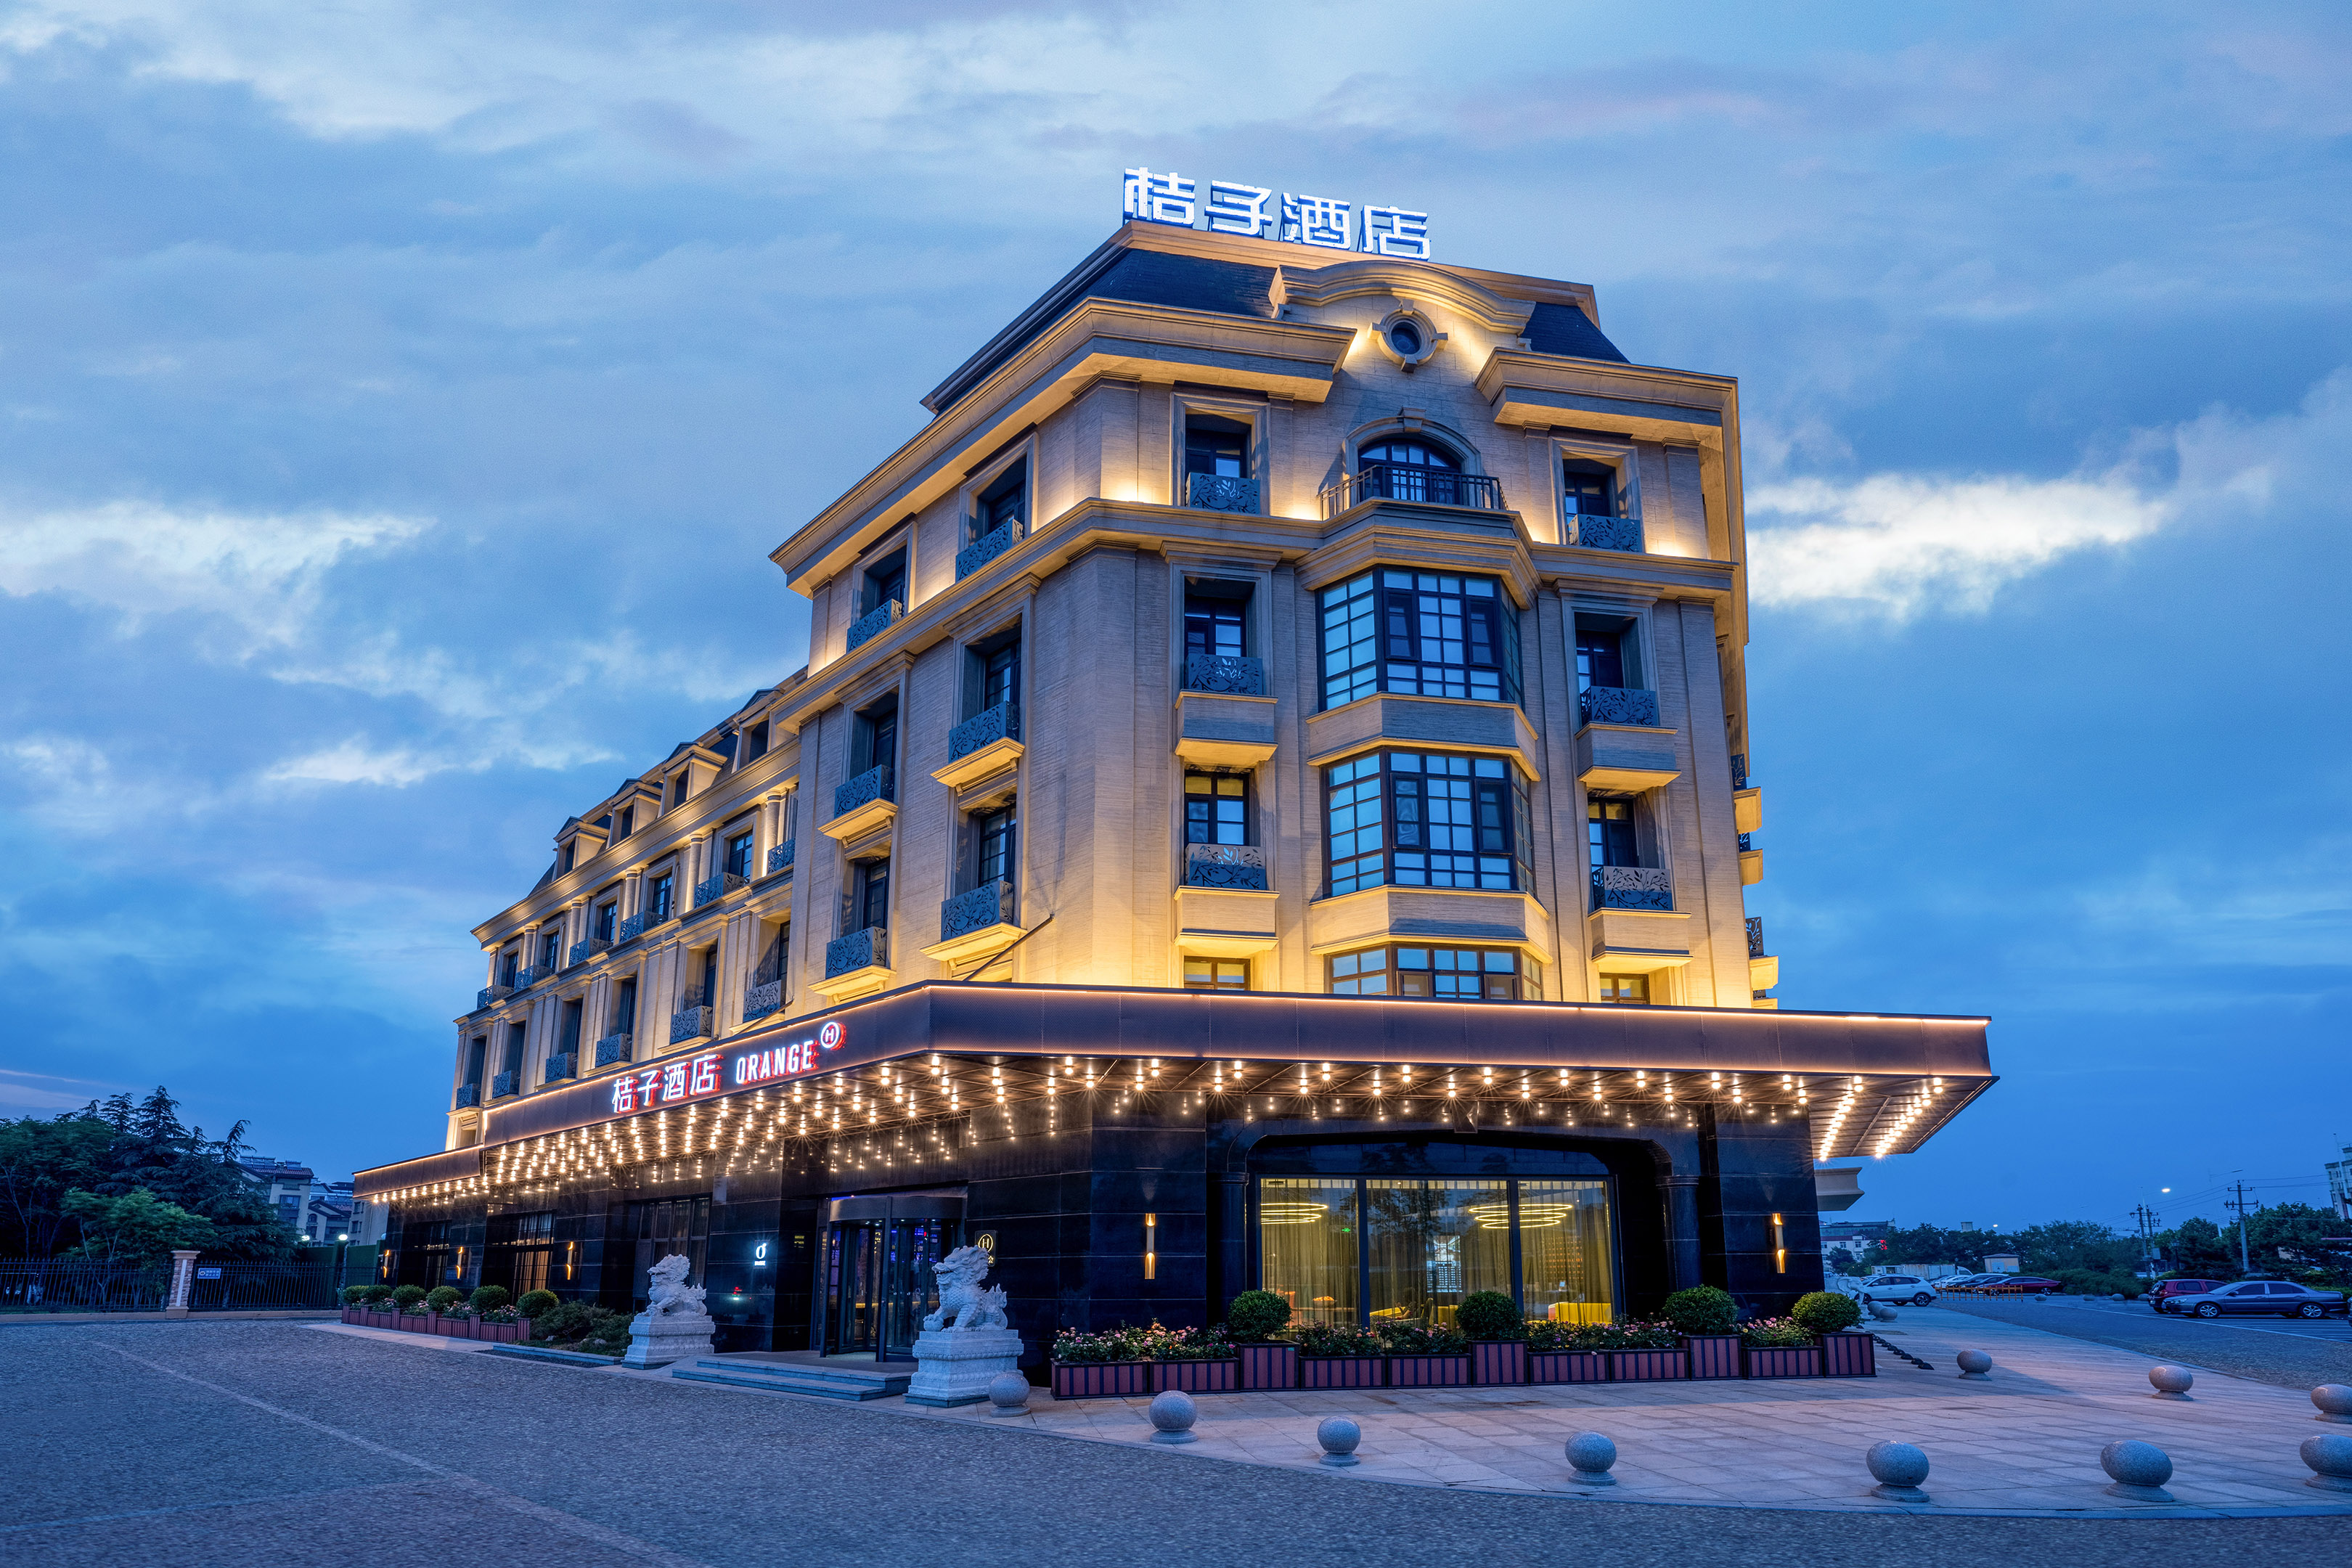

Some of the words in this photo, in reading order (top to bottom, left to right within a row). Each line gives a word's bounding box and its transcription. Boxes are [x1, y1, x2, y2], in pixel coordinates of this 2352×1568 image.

[1124, 166, 1431, 261] 桔子酒店
[612, 1054, 720, 1114] 桔子酒店
[735, 1040, 816, 1085] ORANGE
